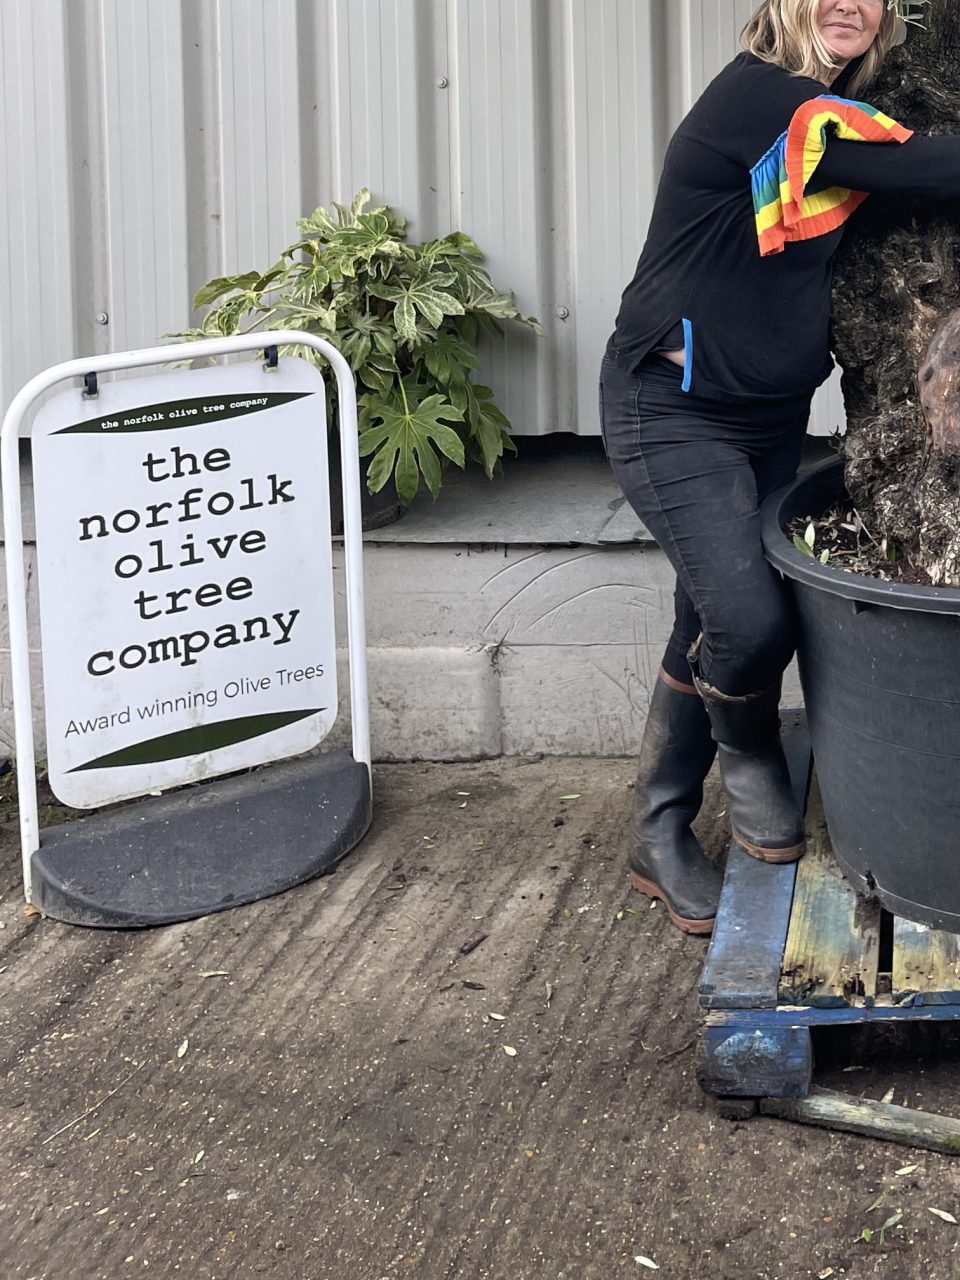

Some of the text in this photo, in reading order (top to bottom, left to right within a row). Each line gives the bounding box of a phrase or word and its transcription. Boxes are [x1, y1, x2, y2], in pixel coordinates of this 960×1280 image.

[101, 397, 268, 430] the norfolk olive tree company
[142, 446, 231, 483] the
[79, 473, 296, 541] norfolk
[114, 530, 267, 580] olive
[133, 576, 254, 620] tree
[87, 609, 301, 678] company
[64, 663, 324, 739] Award winning Olive Trees
